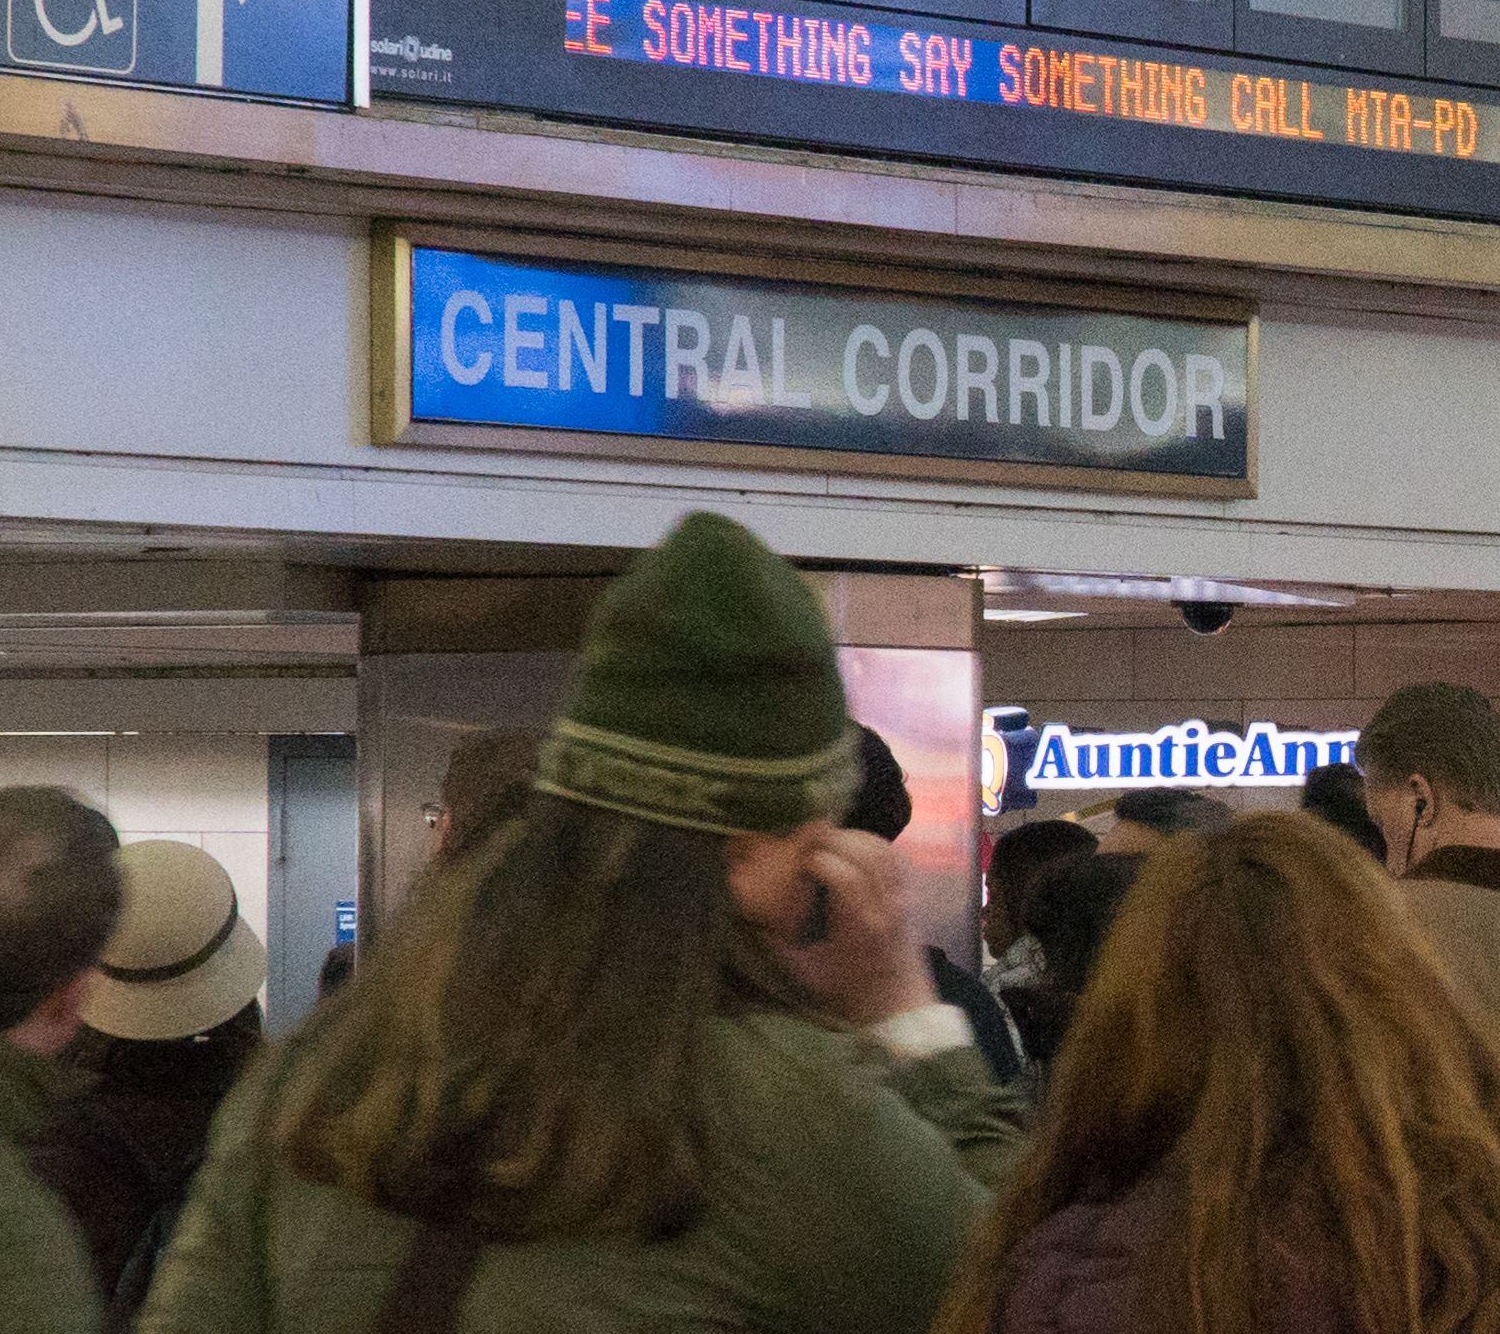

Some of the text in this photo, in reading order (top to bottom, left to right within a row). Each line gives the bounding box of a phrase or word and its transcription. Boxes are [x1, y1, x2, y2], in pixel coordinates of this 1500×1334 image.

[419, 43, 453, 62] udine
[899, 32, 972, 97] SAY
[1000, 44, 1207, 126] SOMETHING
[1231, 73, 1324, 141] CALL
[1346, 87, 1478, 159] MTA-PD
[441, 289, 1226, 440] CENTRAL CORRIDOR
